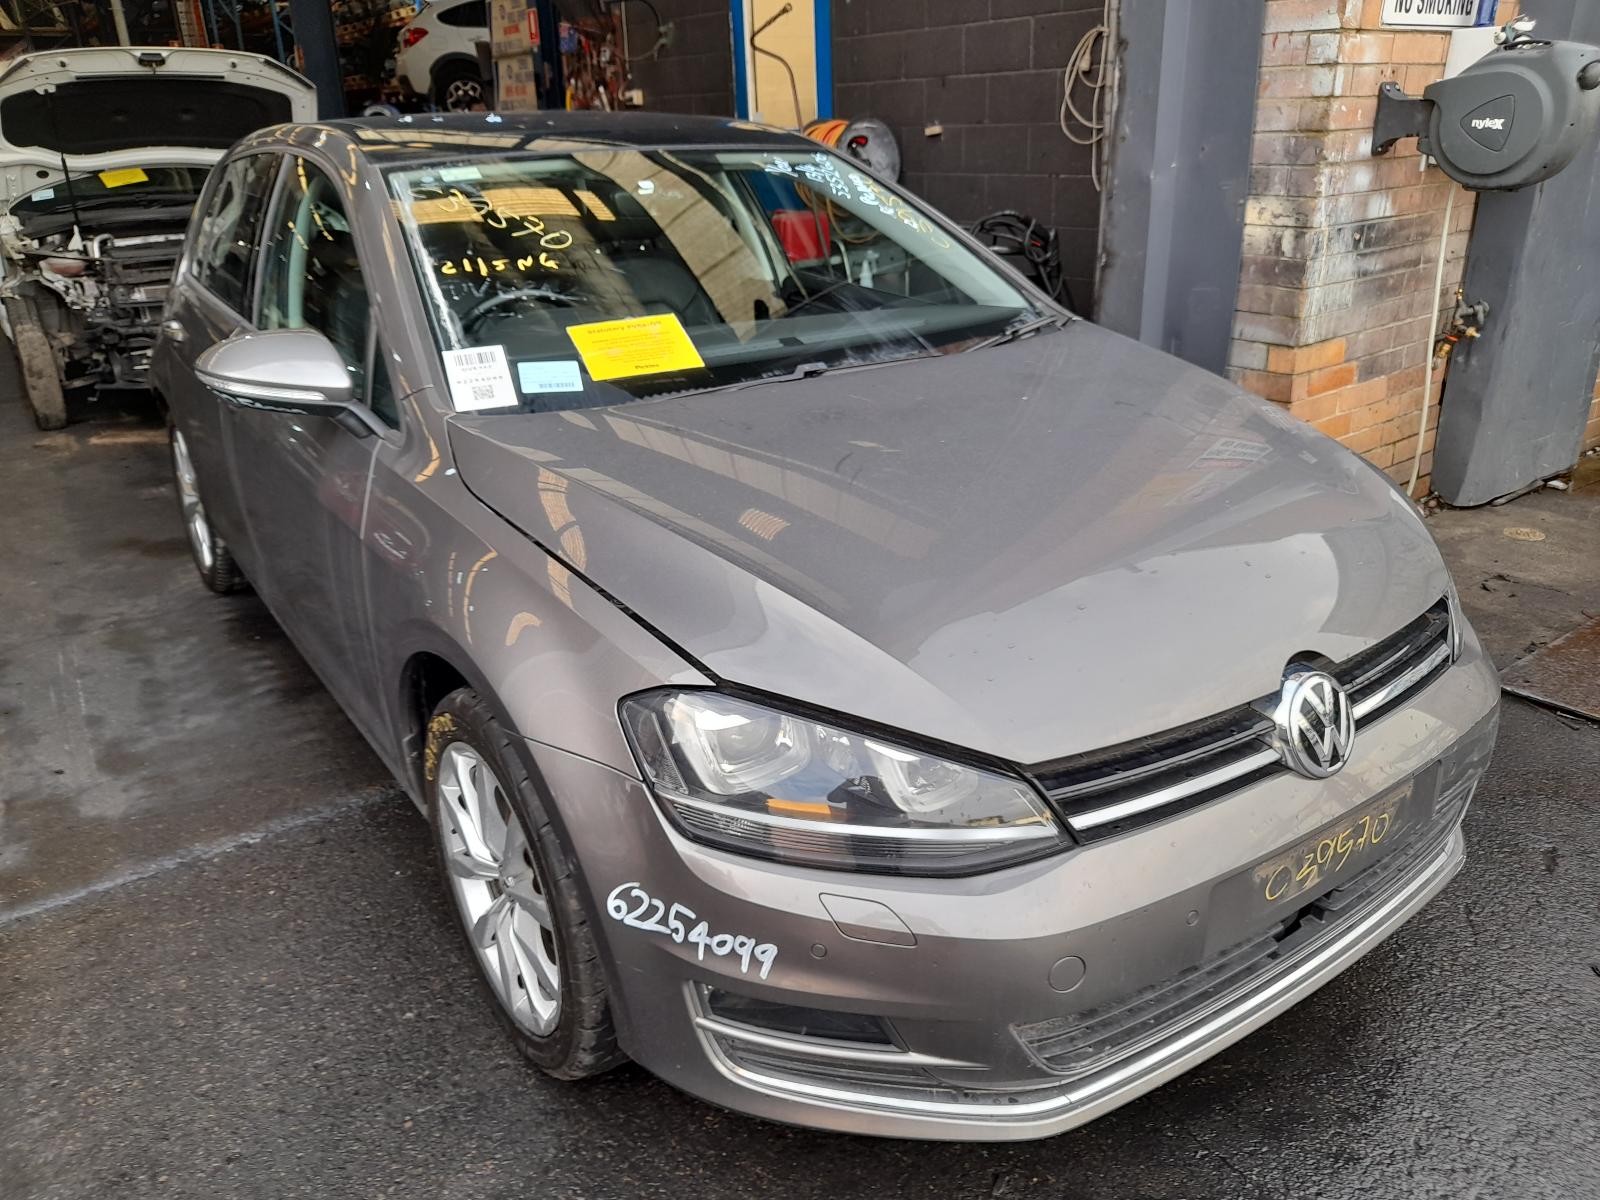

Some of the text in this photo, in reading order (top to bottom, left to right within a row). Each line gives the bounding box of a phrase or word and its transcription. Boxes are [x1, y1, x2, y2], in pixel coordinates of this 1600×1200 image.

[1394, 0, 1474, 16] NO SMOKING
[607, 882, 778, 980] 62254099
